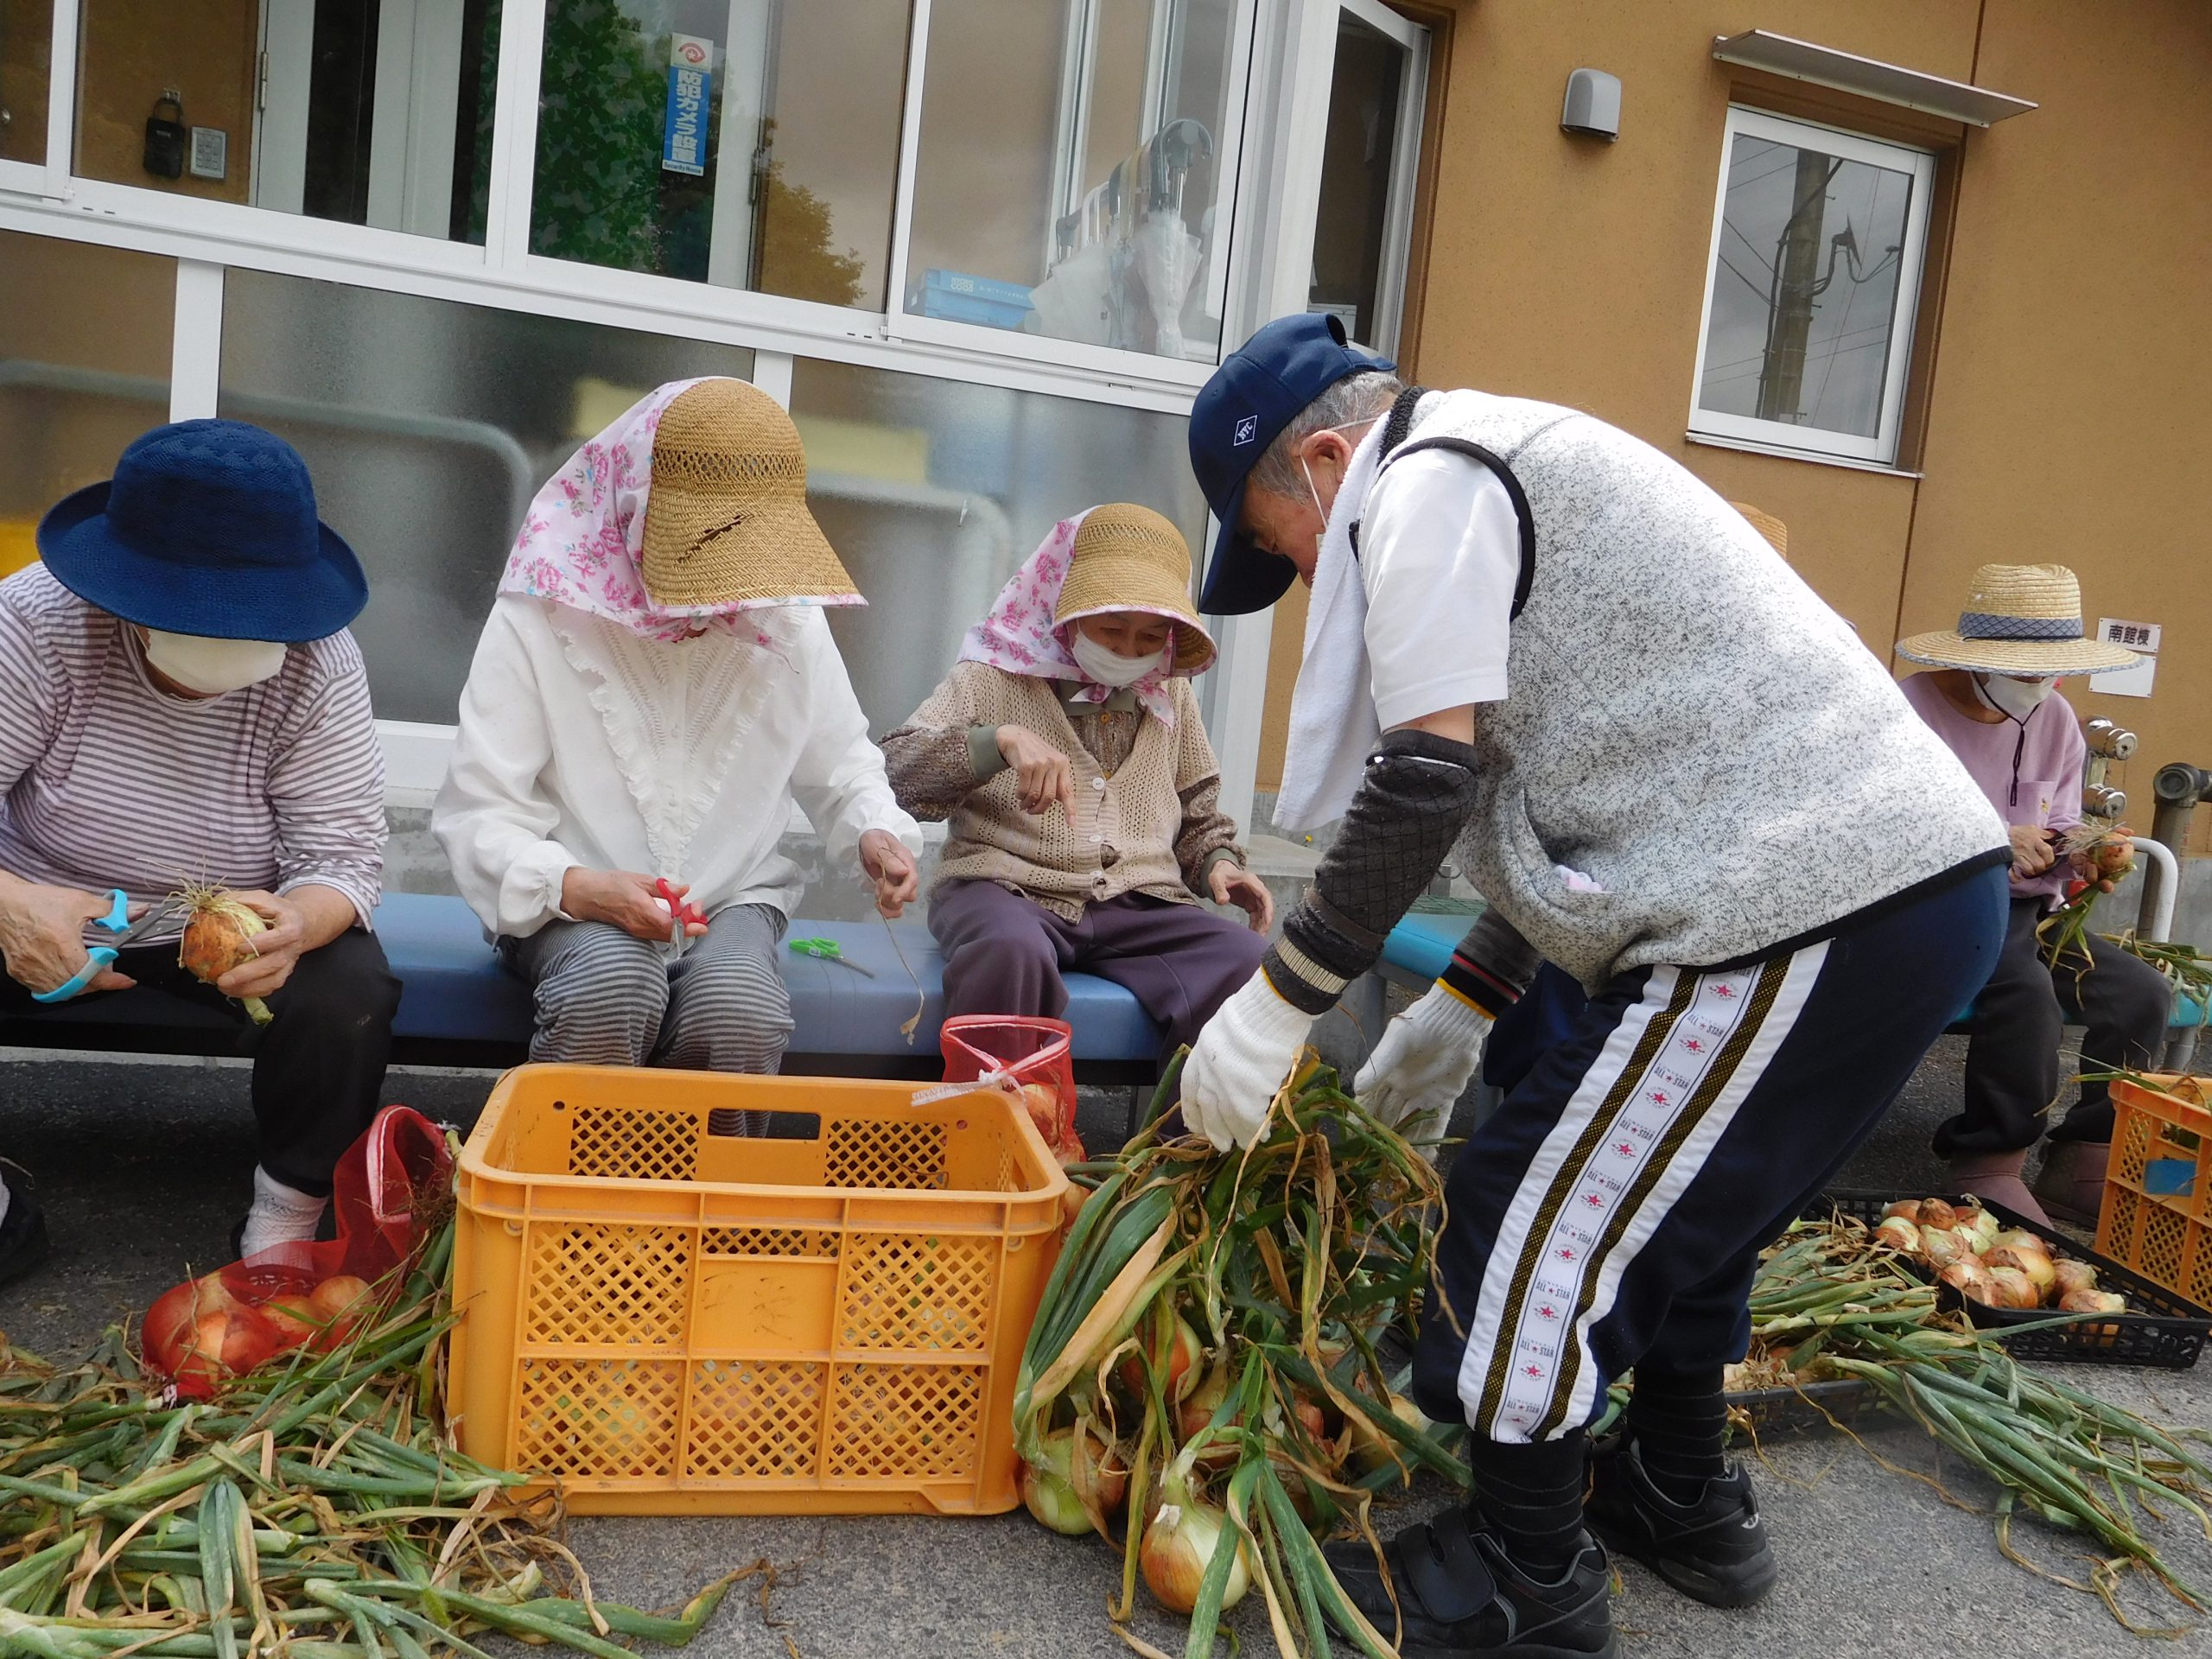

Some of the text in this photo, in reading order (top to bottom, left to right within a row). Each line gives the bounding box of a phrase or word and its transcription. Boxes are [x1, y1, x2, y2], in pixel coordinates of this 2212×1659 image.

[1237, 421, 1253, 441] NYC
[2107, 625, 2151, 646] 南館棟
[1688, 1014, 1698, 1026] ALL
[1707, 1025, 1725, 1038] STAR
[1654, 1066, 1664, 1078] ALL
[1673, 1077, 1689, 1090] STAR
[1619, 1119, 1629, 1131] ALL
[1637, 1129, 1654, 1141] STAR
[1586, 1170, 1597, 1182] ALL
[1605, 1179, 1622, 1192] STAR
[1559, 1223, 1569, 1235] ALL
[1577, 1233, 1592, 1245] STAR
[1535, 1281, 1546, 1292] ALL
[1554, 1288, 1571, 1300] STAR
[1520, 1340, 1529, 1351] ALL
[1539, 1346, 1554, 1357] STAR
[1506, 1401, 1516, 1410] ALL
[1525, 1405, 1540, 1414] STAR
